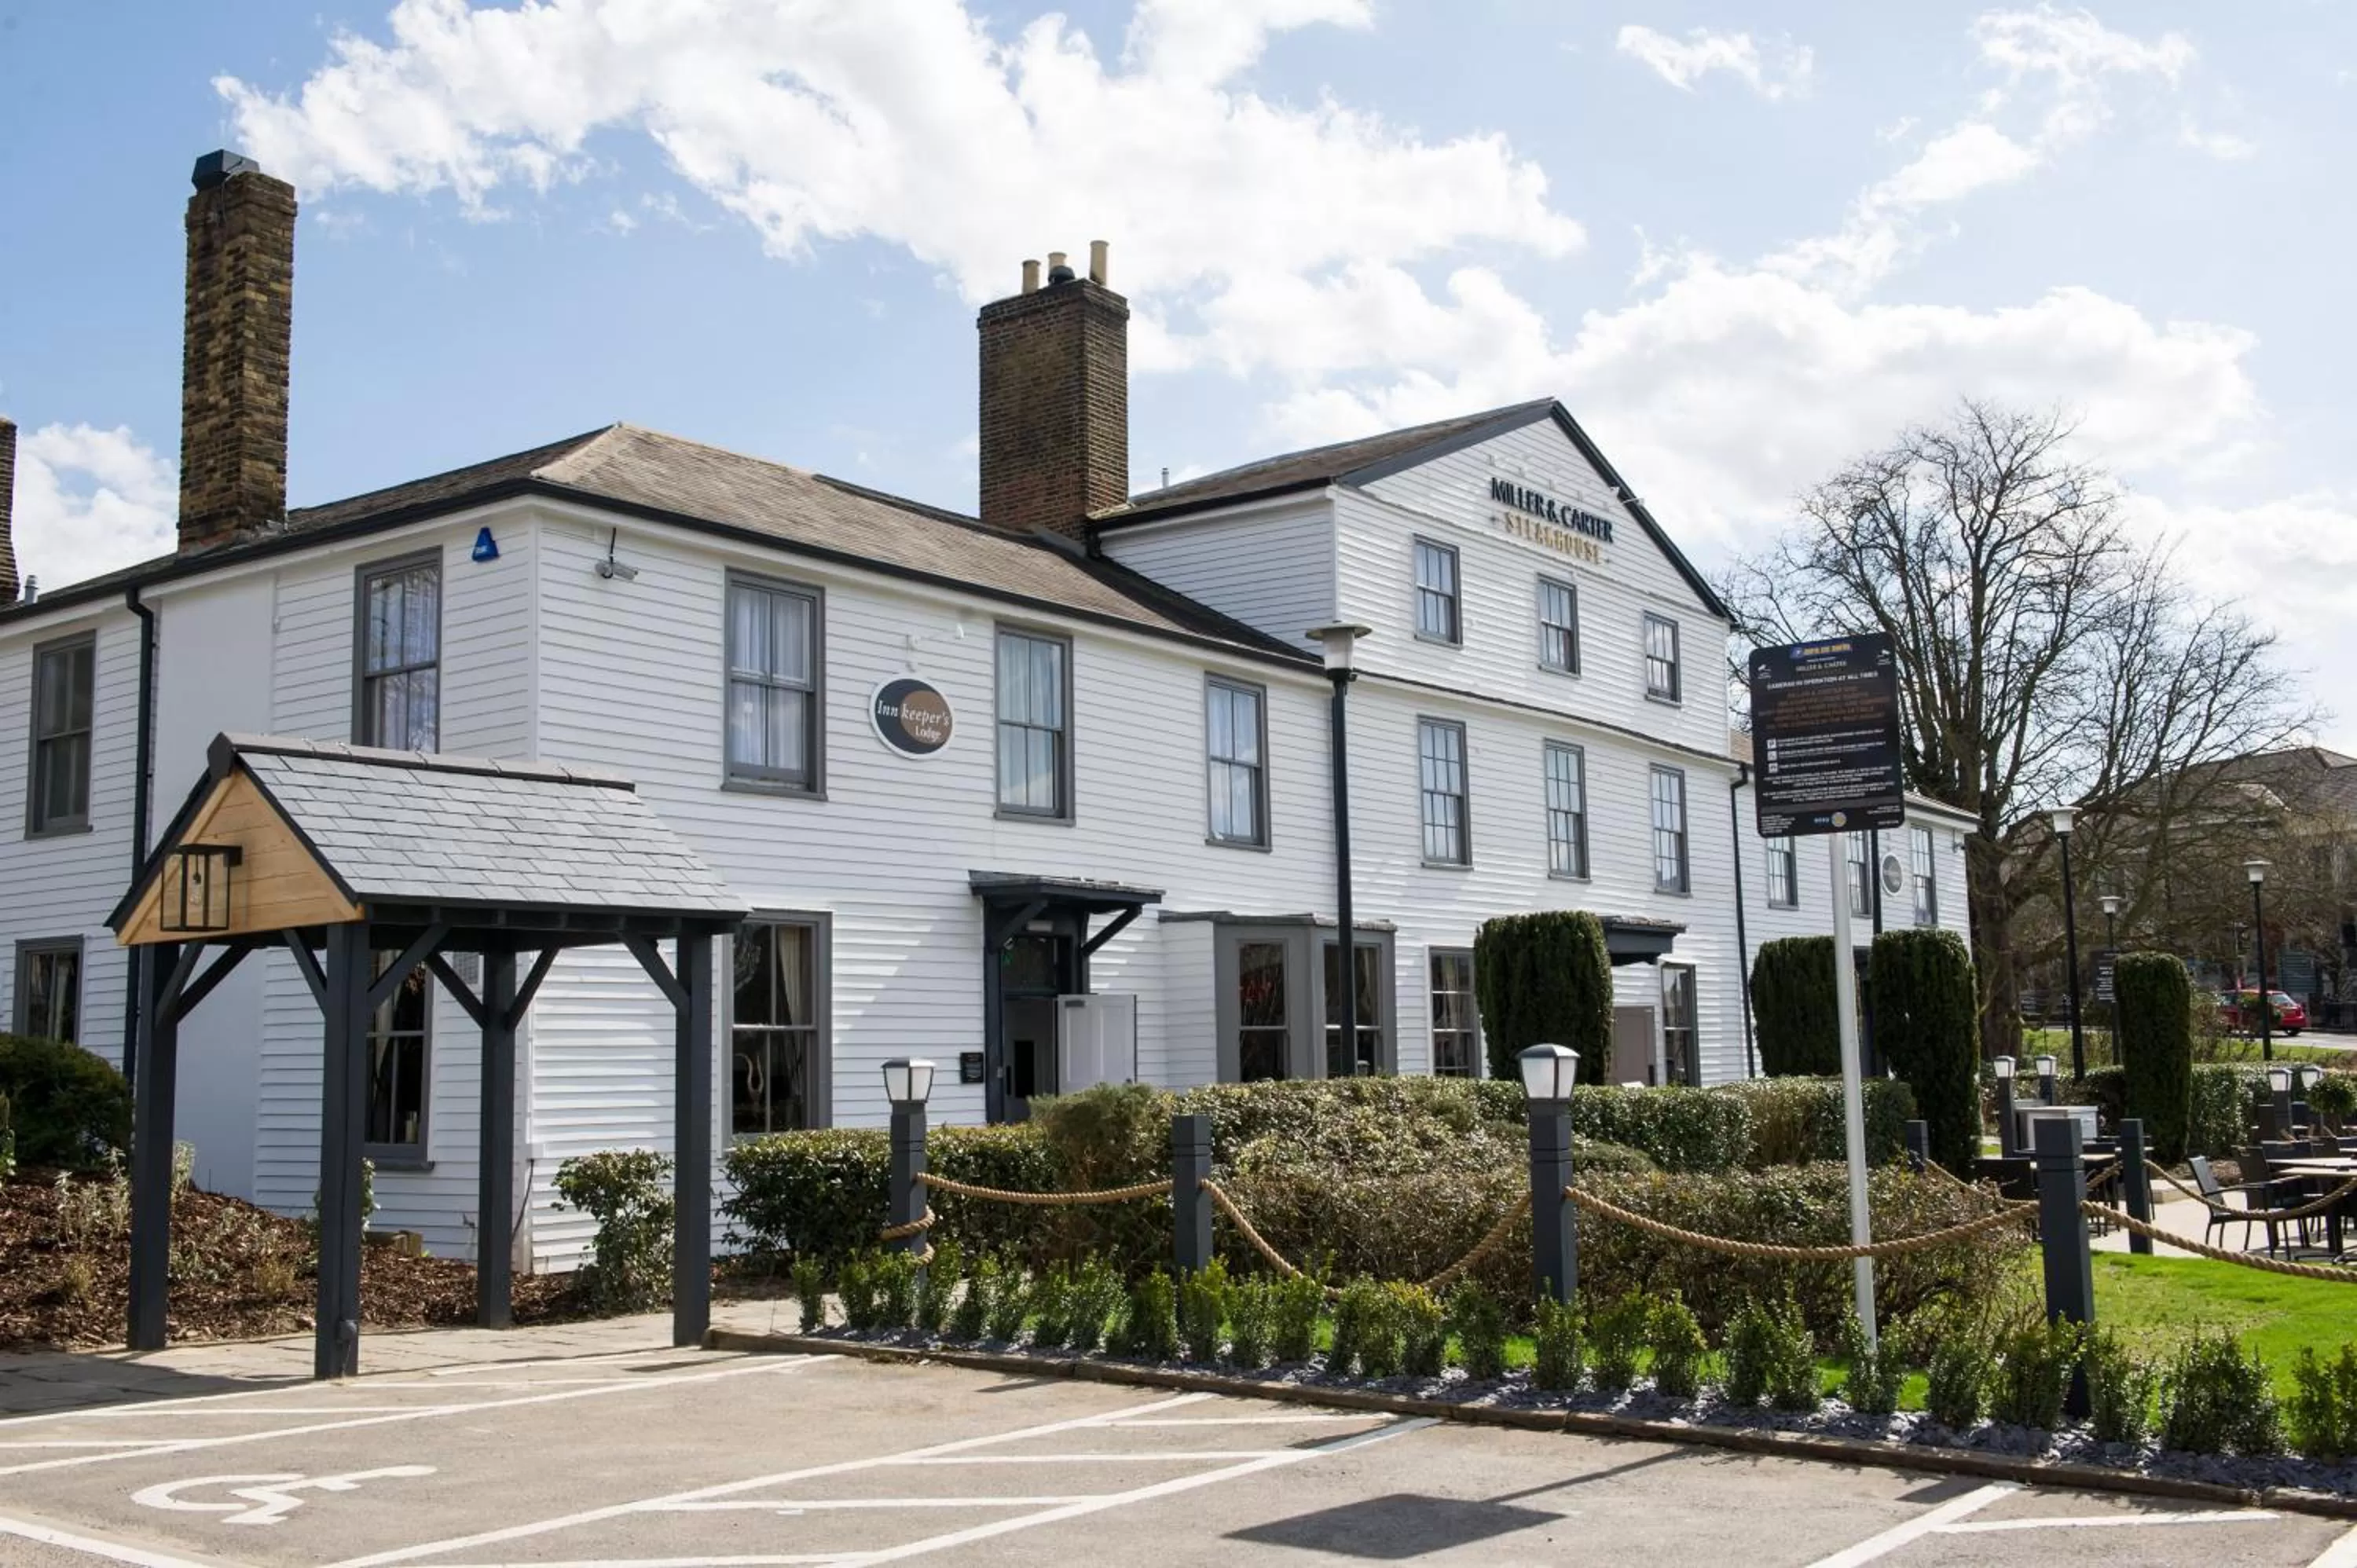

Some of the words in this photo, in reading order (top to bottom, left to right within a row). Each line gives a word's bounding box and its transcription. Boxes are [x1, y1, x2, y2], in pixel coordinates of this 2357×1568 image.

[1491, 477, 1545, 518] MILLER
[1547, 499, 1560, 524] &
[1561, 505, 1613, 544] CARTER
[1505, 511, 1602, 565] STEAKHOUSE
